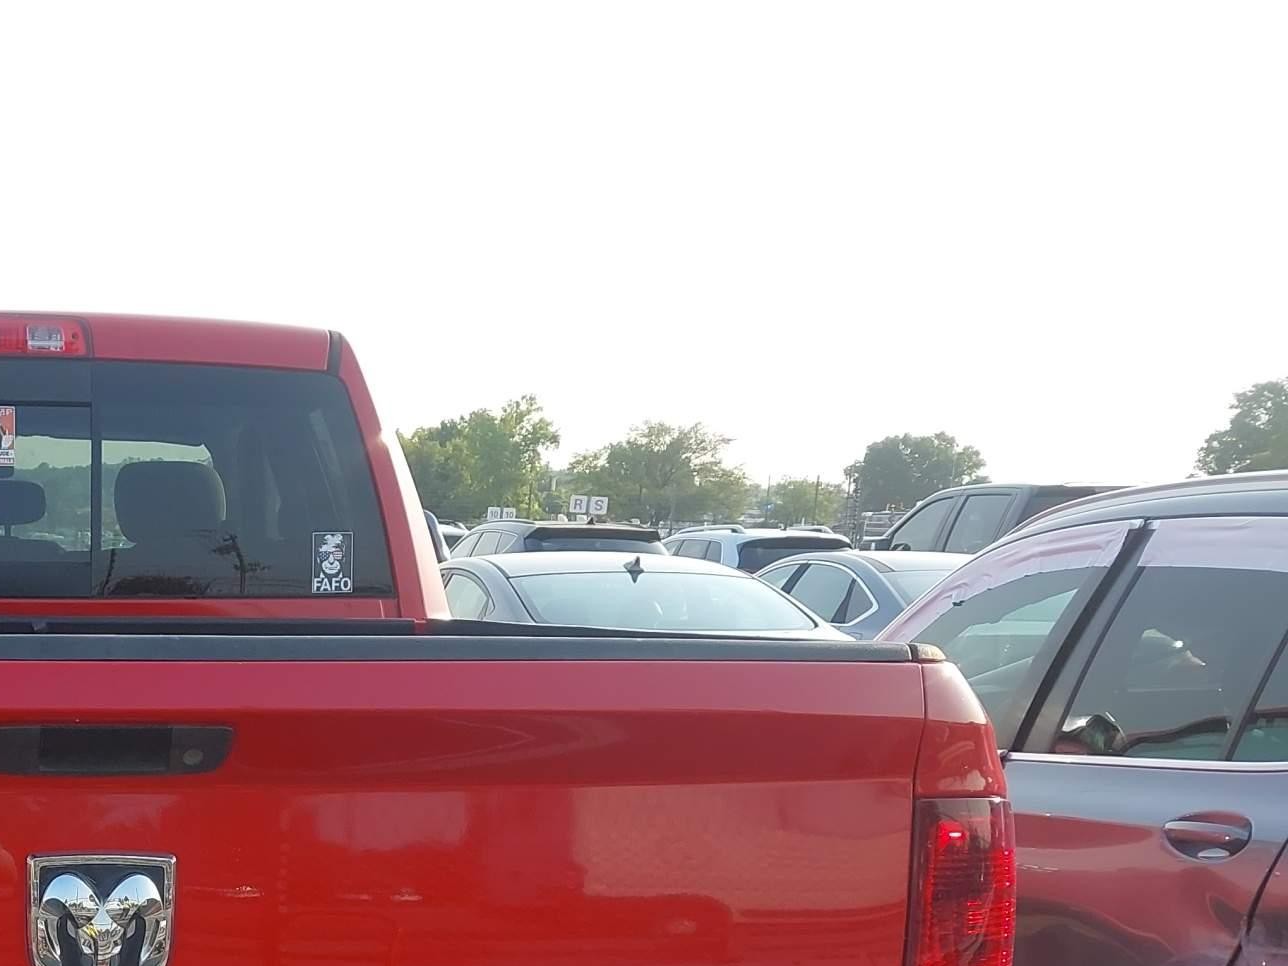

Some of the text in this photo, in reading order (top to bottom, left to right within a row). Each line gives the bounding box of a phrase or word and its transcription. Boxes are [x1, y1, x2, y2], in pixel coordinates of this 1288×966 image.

[573, 499, 583, 510] R
[594, 499, 604, 511] S
[314, 578, 351, 591] FAFO
